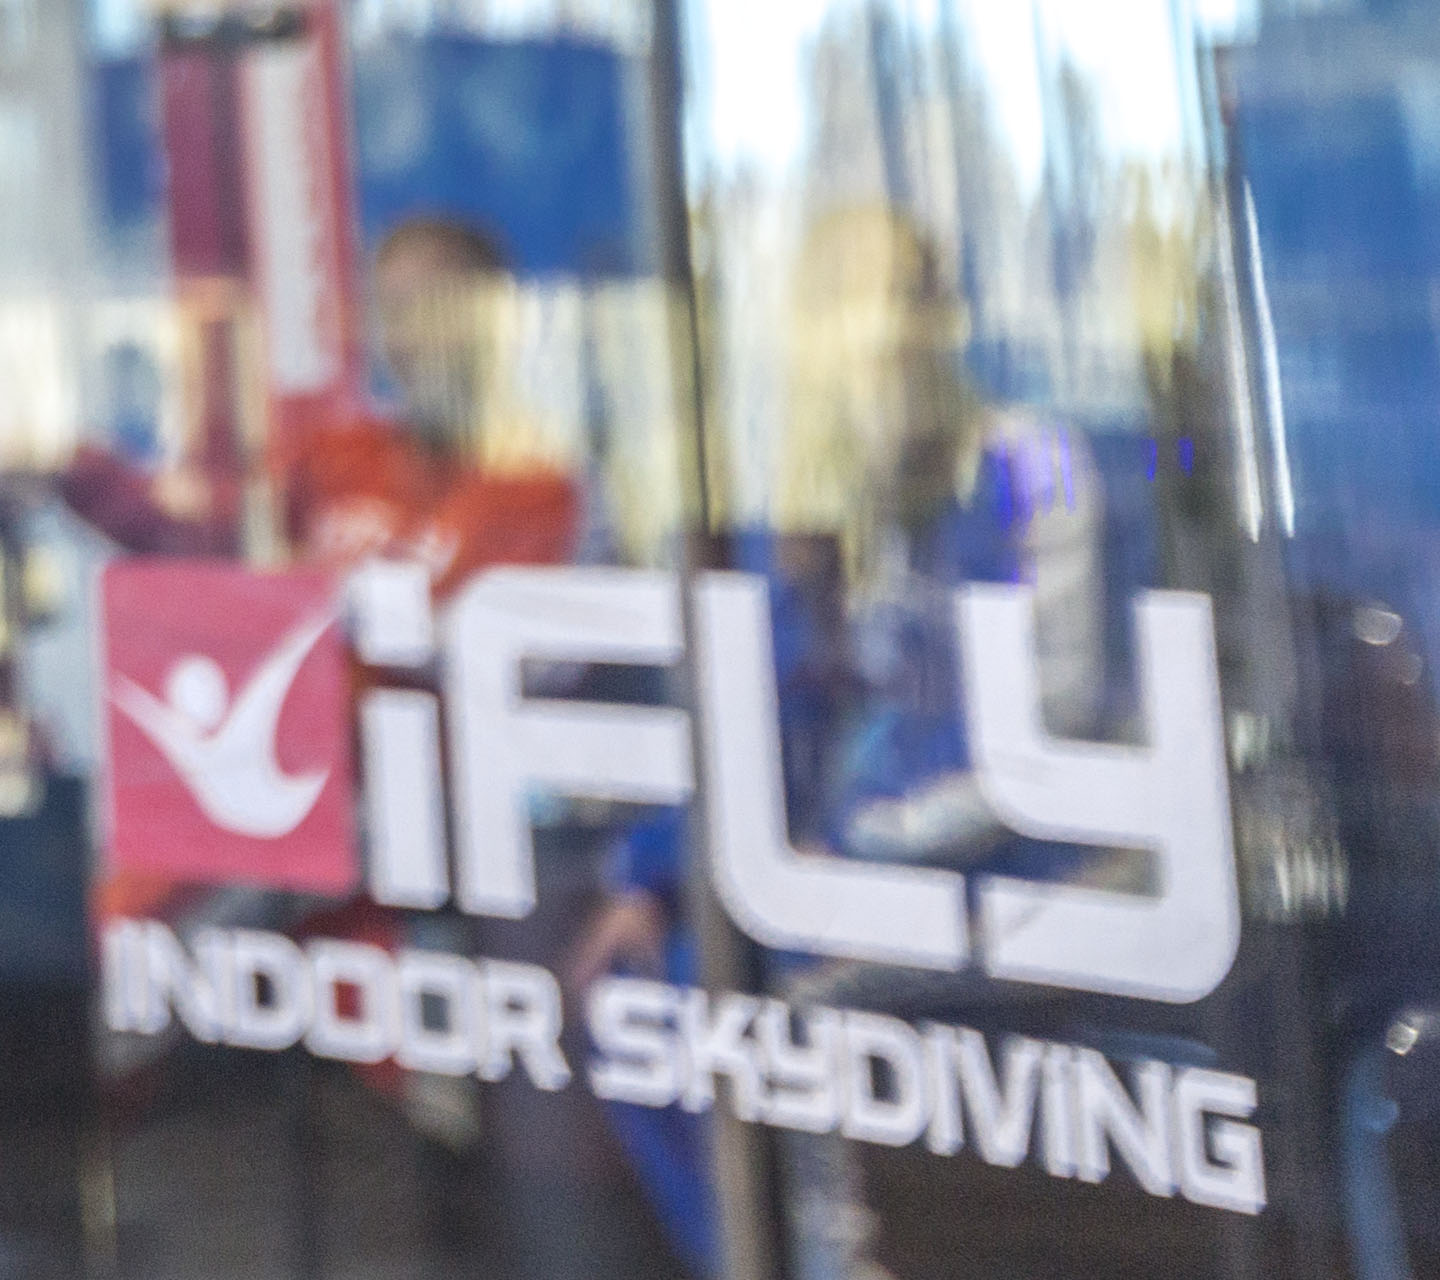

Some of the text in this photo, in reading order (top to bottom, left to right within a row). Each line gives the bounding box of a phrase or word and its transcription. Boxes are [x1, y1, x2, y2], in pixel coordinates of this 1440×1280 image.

[346, 558, 1240, 1004] iFLY
[100, 917, 1268, 1216] INDOOR SKYDIVING
